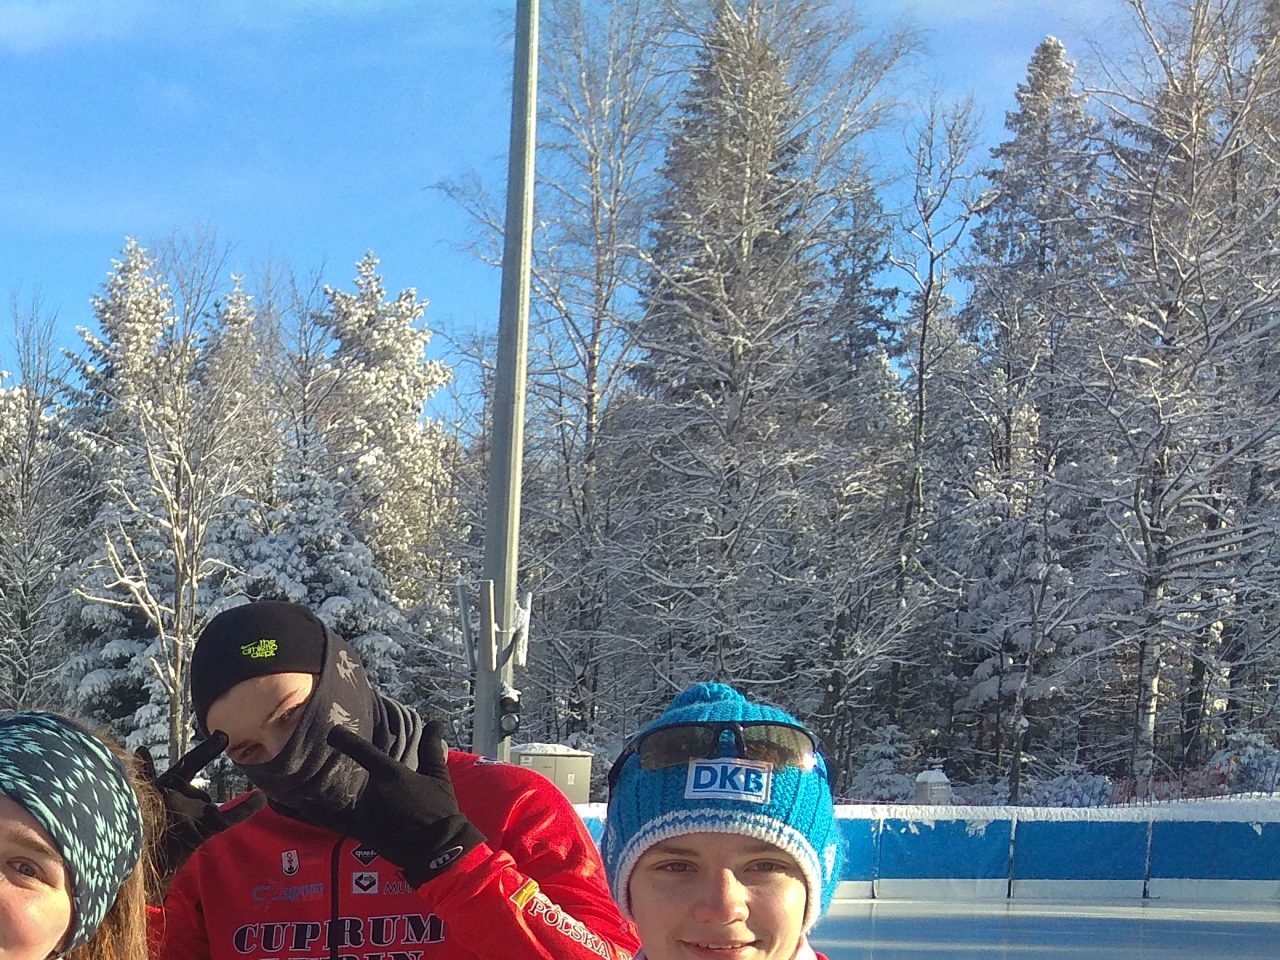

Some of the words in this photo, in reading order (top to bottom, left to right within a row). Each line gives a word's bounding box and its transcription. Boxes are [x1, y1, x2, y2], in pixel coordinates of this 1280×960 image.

[693, 765, 763, 793] DKB
[233, 914, 446, 954] CUPRUM
[528, 898, 611, 960] POLSKA
